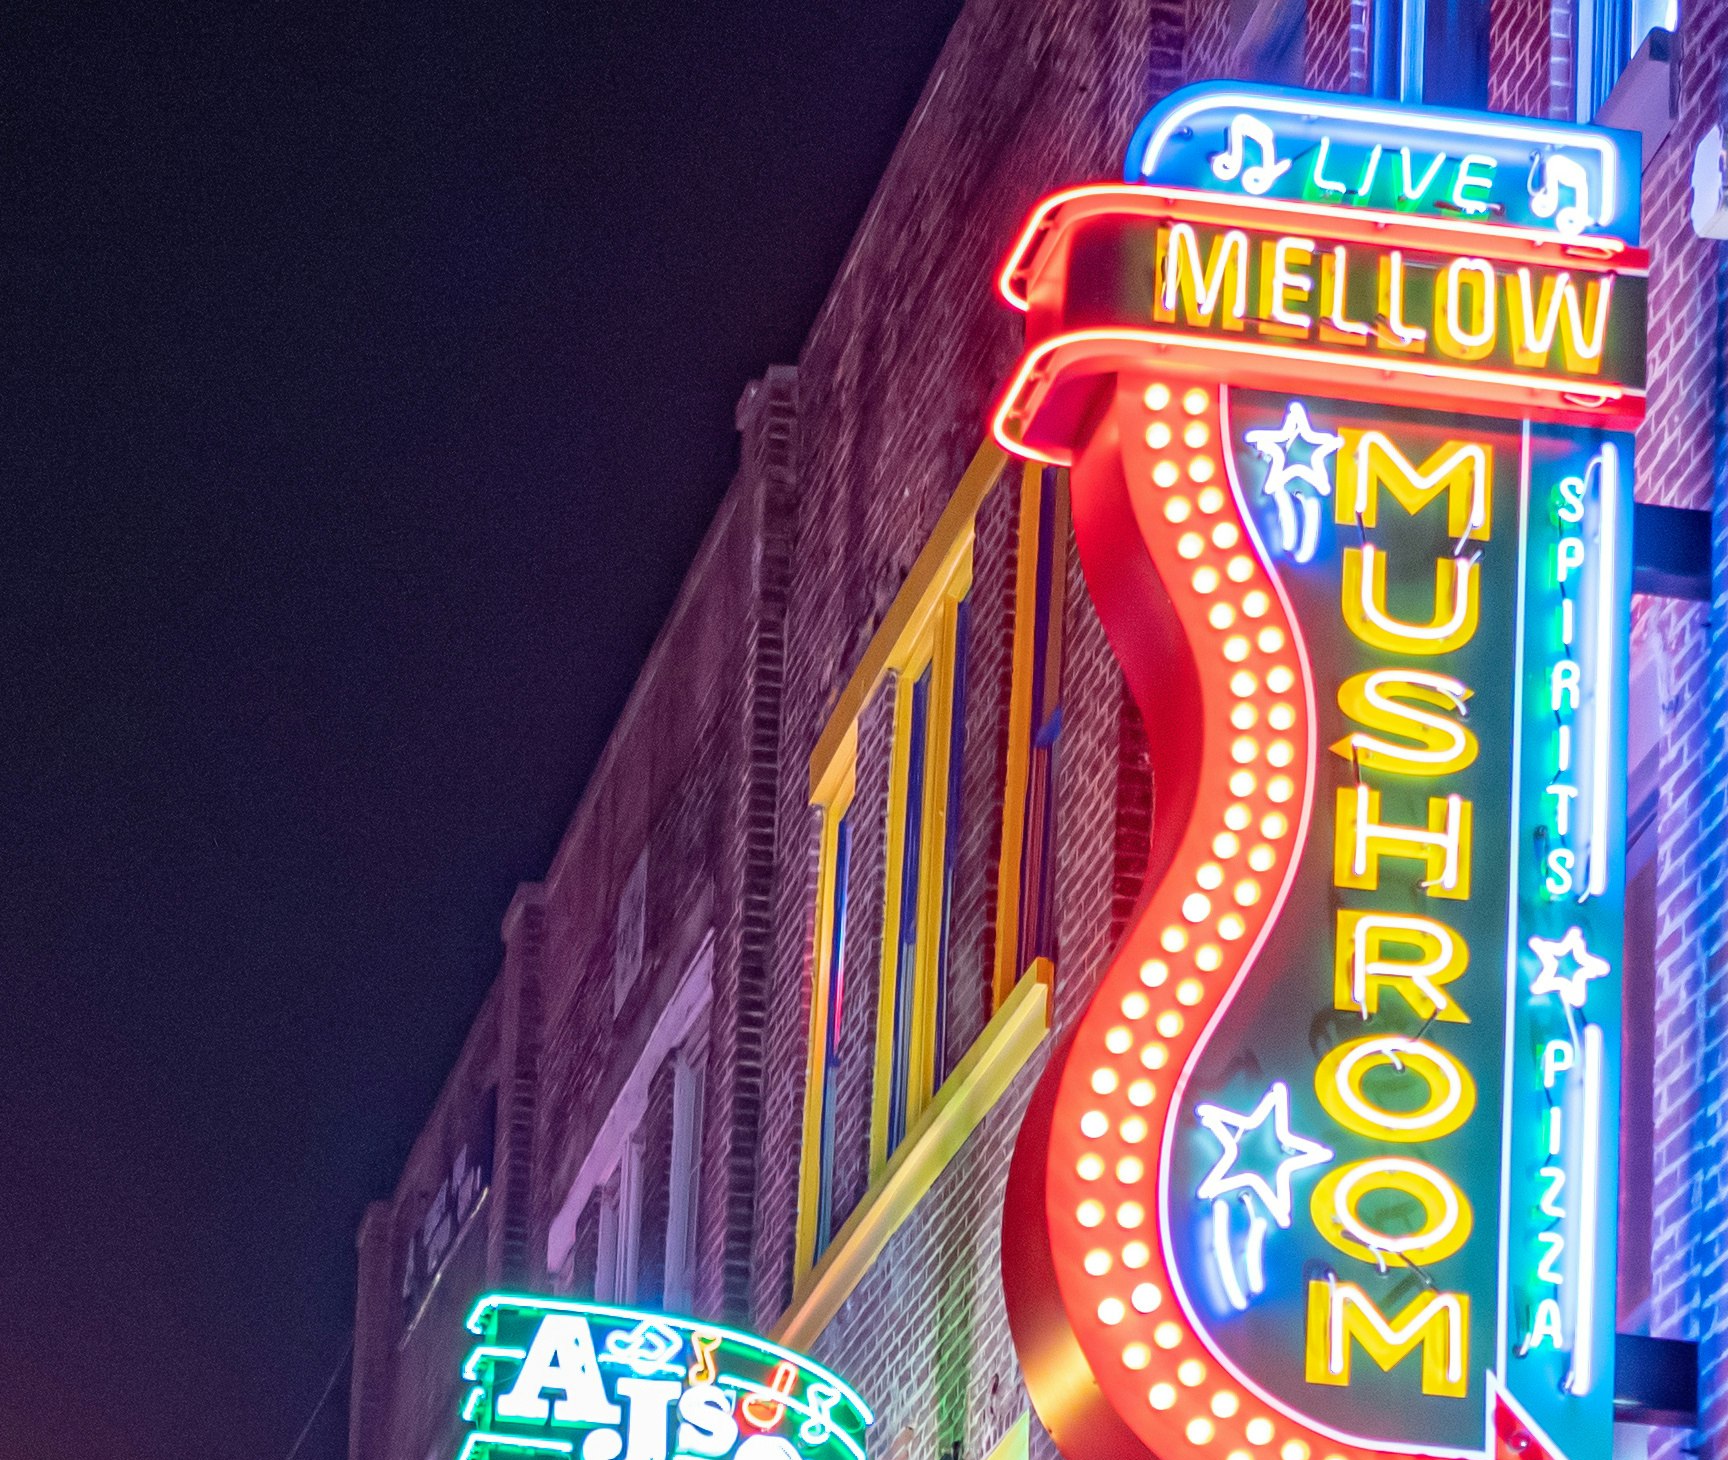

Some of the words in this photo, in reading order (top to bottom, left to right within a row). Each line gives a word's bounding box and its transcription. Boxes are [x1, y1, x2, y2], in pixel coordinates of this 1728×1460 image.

[1152, 221, 1616, 376] MELLOW
[1304, 135, 1502, 213] LIVE
[1542, 475, 1587, 902] SPIRITS
[1306, 427, 1494, 1399] MUSHROOM
[1528, 1036, 1576, 1352] PIZZA
